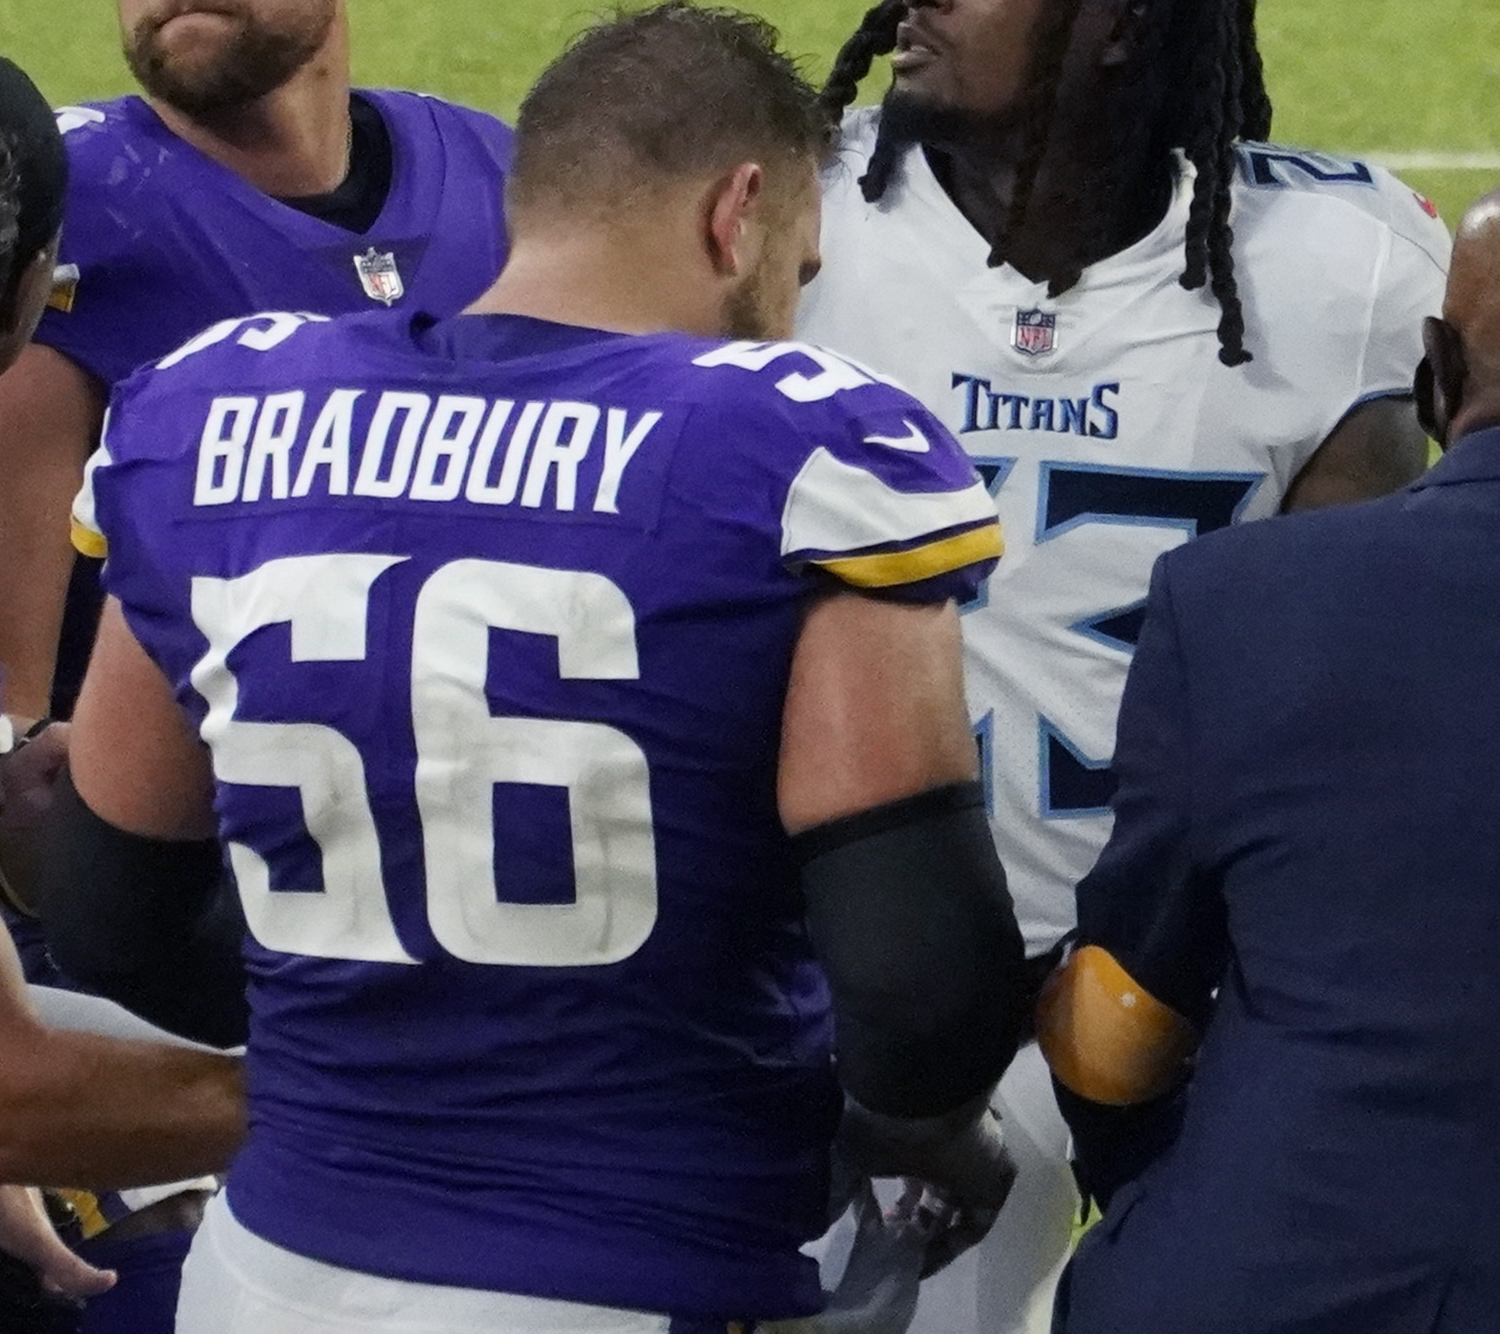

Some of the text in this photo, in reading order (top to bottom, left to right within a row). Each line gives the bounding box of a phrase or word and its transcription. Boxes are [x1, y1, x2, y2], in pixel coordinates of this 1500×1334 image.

[1019, 326, 1051, 348] NFL
[191, 388, 664, 515] BRADBURY
[950, 372, 1121, 440] TITANS
[189, 552, 660, 968] 56
